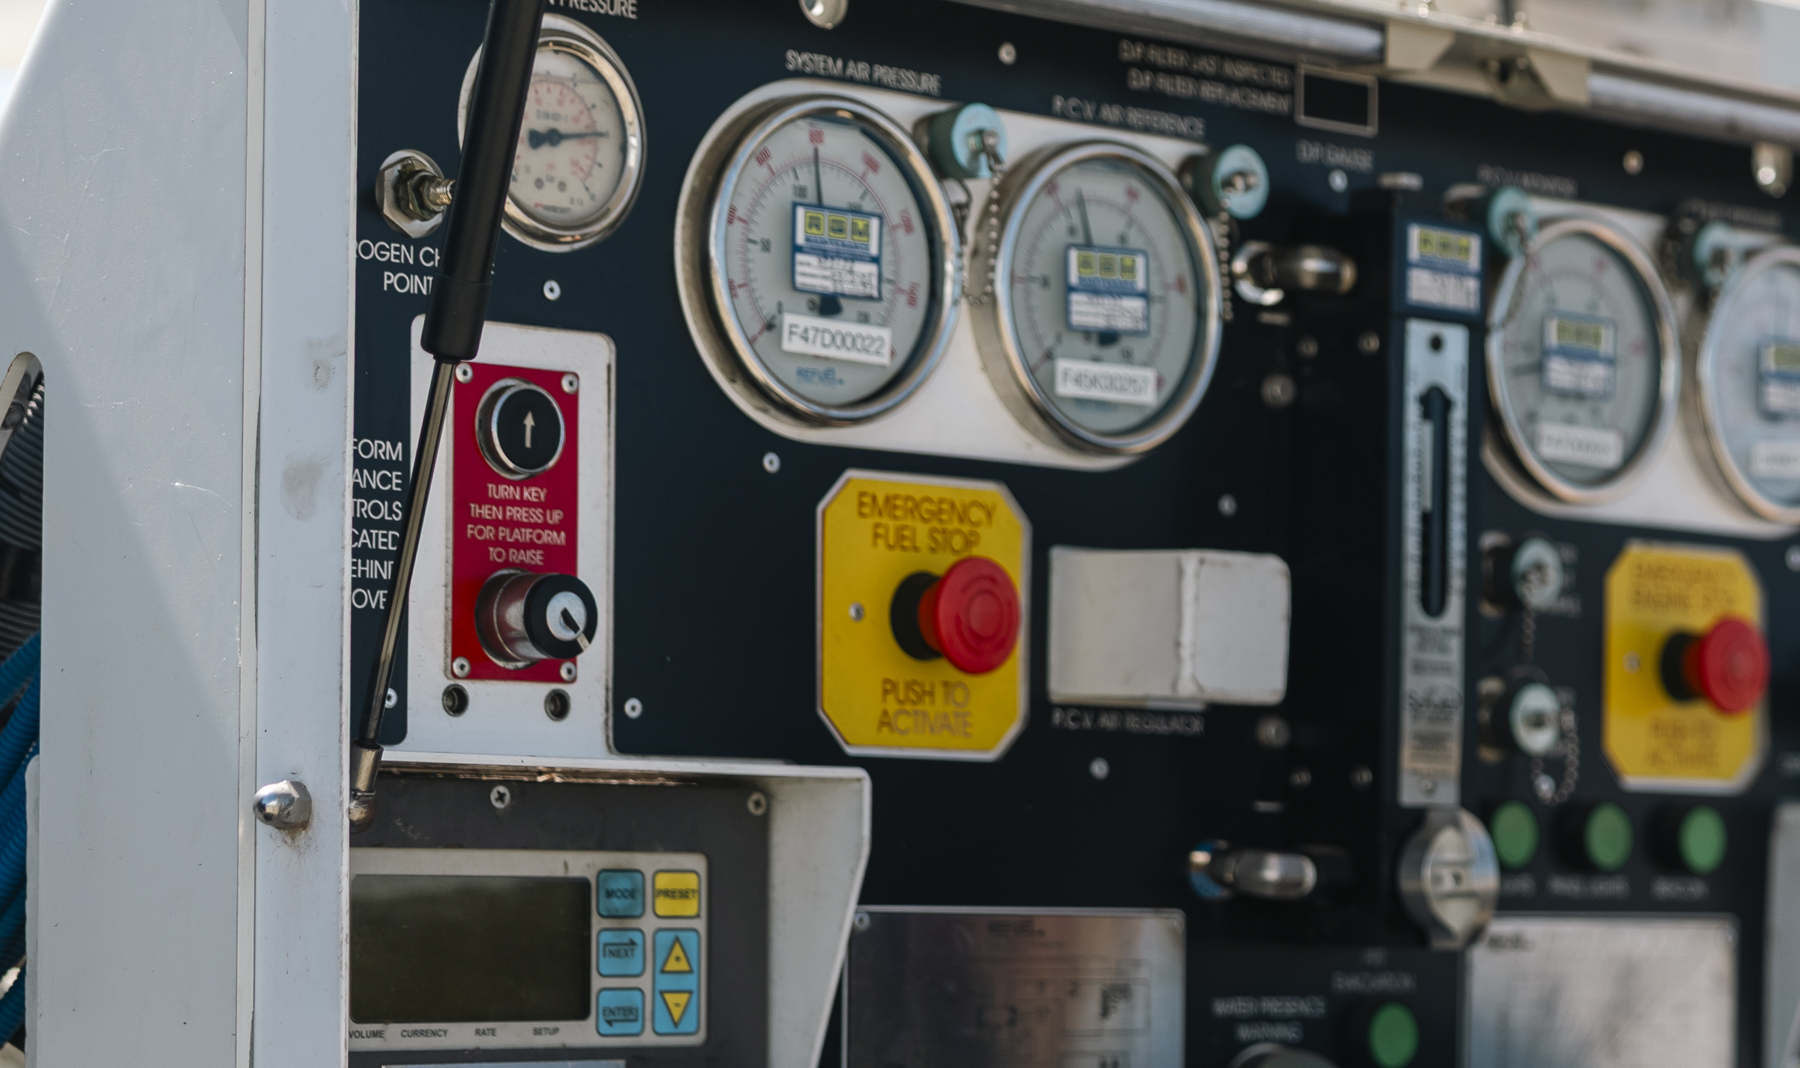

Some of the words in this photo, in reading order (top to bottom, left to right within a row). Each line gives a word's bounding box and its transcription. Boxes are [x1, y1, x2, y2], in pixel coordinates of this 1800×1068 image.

[785, 49, 843, 77] SYSTEM
[845, 60, 870, 82] AIR
[872, 64, 942, 96] PRESSURE
[354, 238, 414, 265] OGEN
[787, 323, 886, 357] F47D00022
[487, 483, 520, 501] TURN
[522, 486, 547, 503] KEY
[469, 503, 503, 520] THEN
[505, 505, 544, 524] PRESS
[546, 509, 564, 525] UP
[857, 490, 998, 528] EMERGENCY
[467, 524, 495, 540] FOR
[498, 526, 566, 546] PLATFORM
[872, 522, 922, 552] FUEL
[927, 526, 981, 556] STOP
[488, 547, 505, 562] TO
[508, 548, 544, 566] RAISE
[352, 587, 388, 610] OVE
[882, 678, 934, 707] PUSH
[941, 681, 971, 709] TO
[877, 708, 974, 739] ACTIVATE
[605, 888, 637, 899] MODE
[656, 888, 698, 899] PRESET
[608, 948, 635, 958] NEXT
[602, 1006, 635, 1017] ENTER
[348, 1029, 385, 1039] VOLUME
[401, 1028, 449, 1038] CURRENCY
[474, 1027, 497, 1037] RATE
[532, 1026, 560, 1037] SETUP
